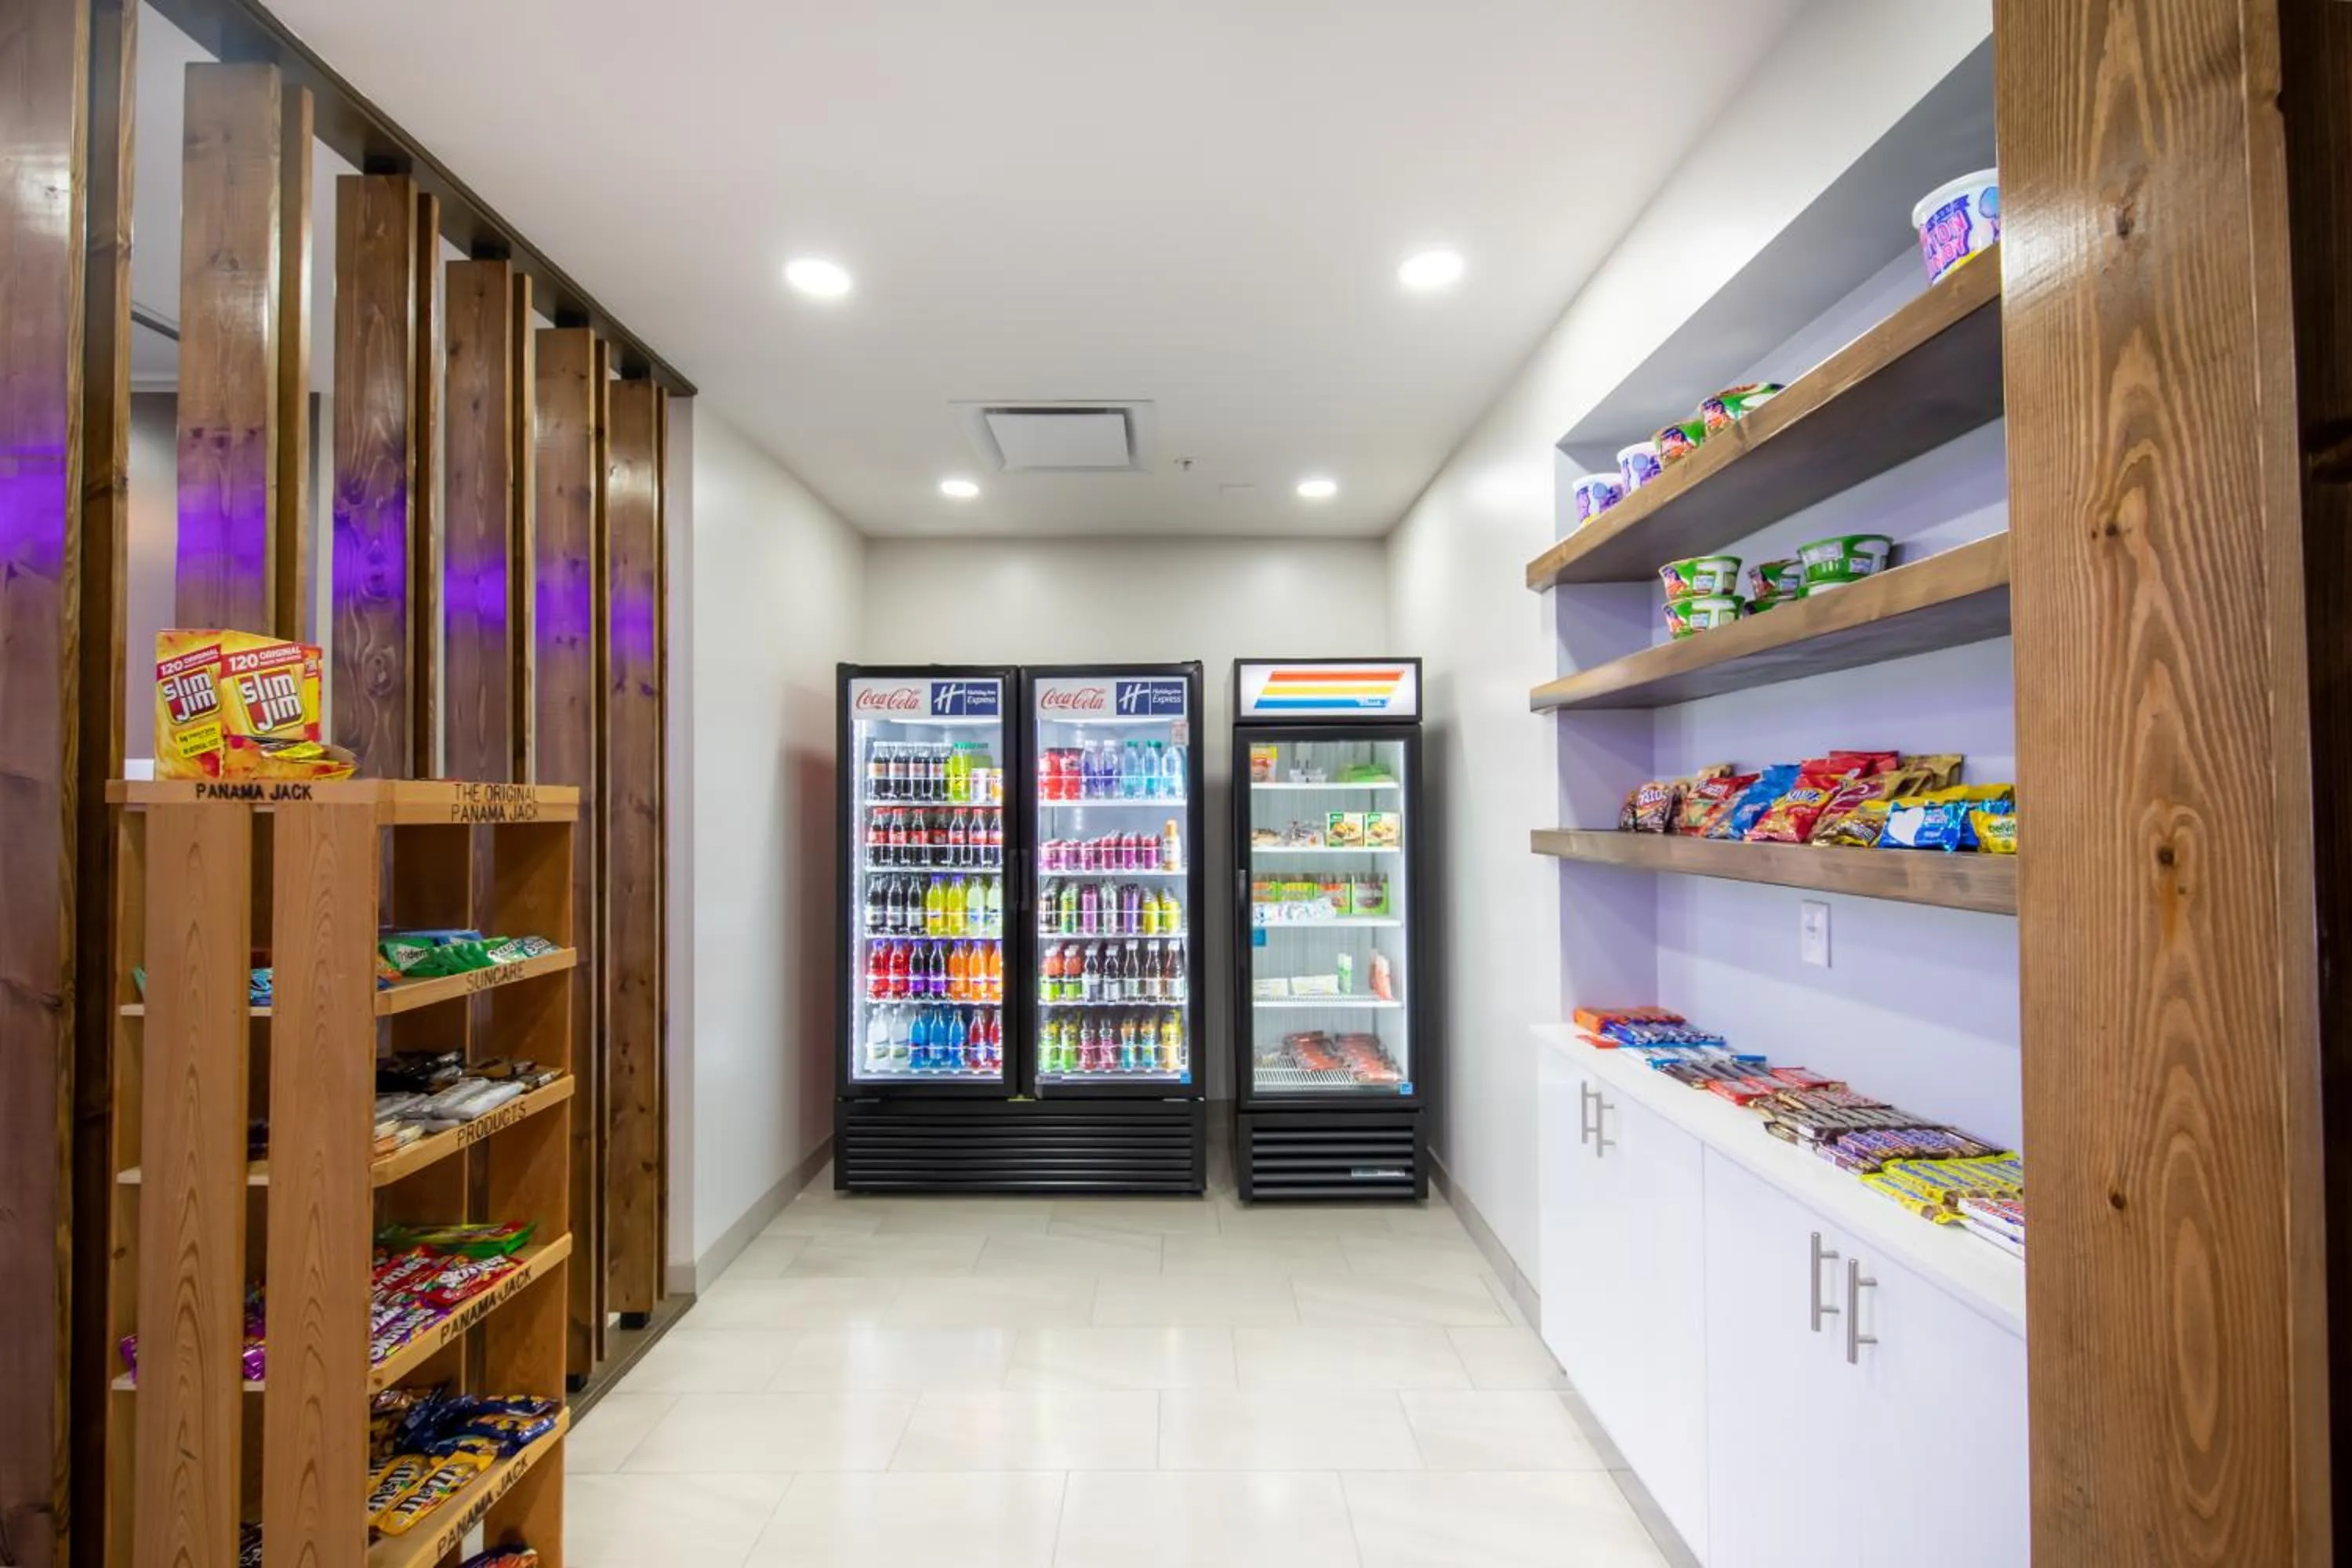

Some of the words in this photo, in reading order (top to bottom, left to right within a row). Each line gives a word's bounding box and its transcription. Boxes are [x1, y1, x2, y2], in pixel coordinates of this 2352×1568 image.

[160, 660, 183, 676] 120
[229, 653, 258, 672] 120
[196, 783, 264, 800] PANAMA
[270, 784, 313, 800] JACK
[454, 784, 481, 802] THE
[485, 785, 538, 804] ORIGINAL
[451, 804, 506, 822] PANAMA
[510, 804, 539, 821] JACK
[466, 960, 526, 992] SUNCARE
[456, 1100, 527, 1146] PRODUCTS
[440, 1291, 497, 1345] PANAMA
[499, 1265, 532, 1300] JACK
[437, 1493, 494, 1558] PANAMA
[496, 1454, 529, 1498] JACK
